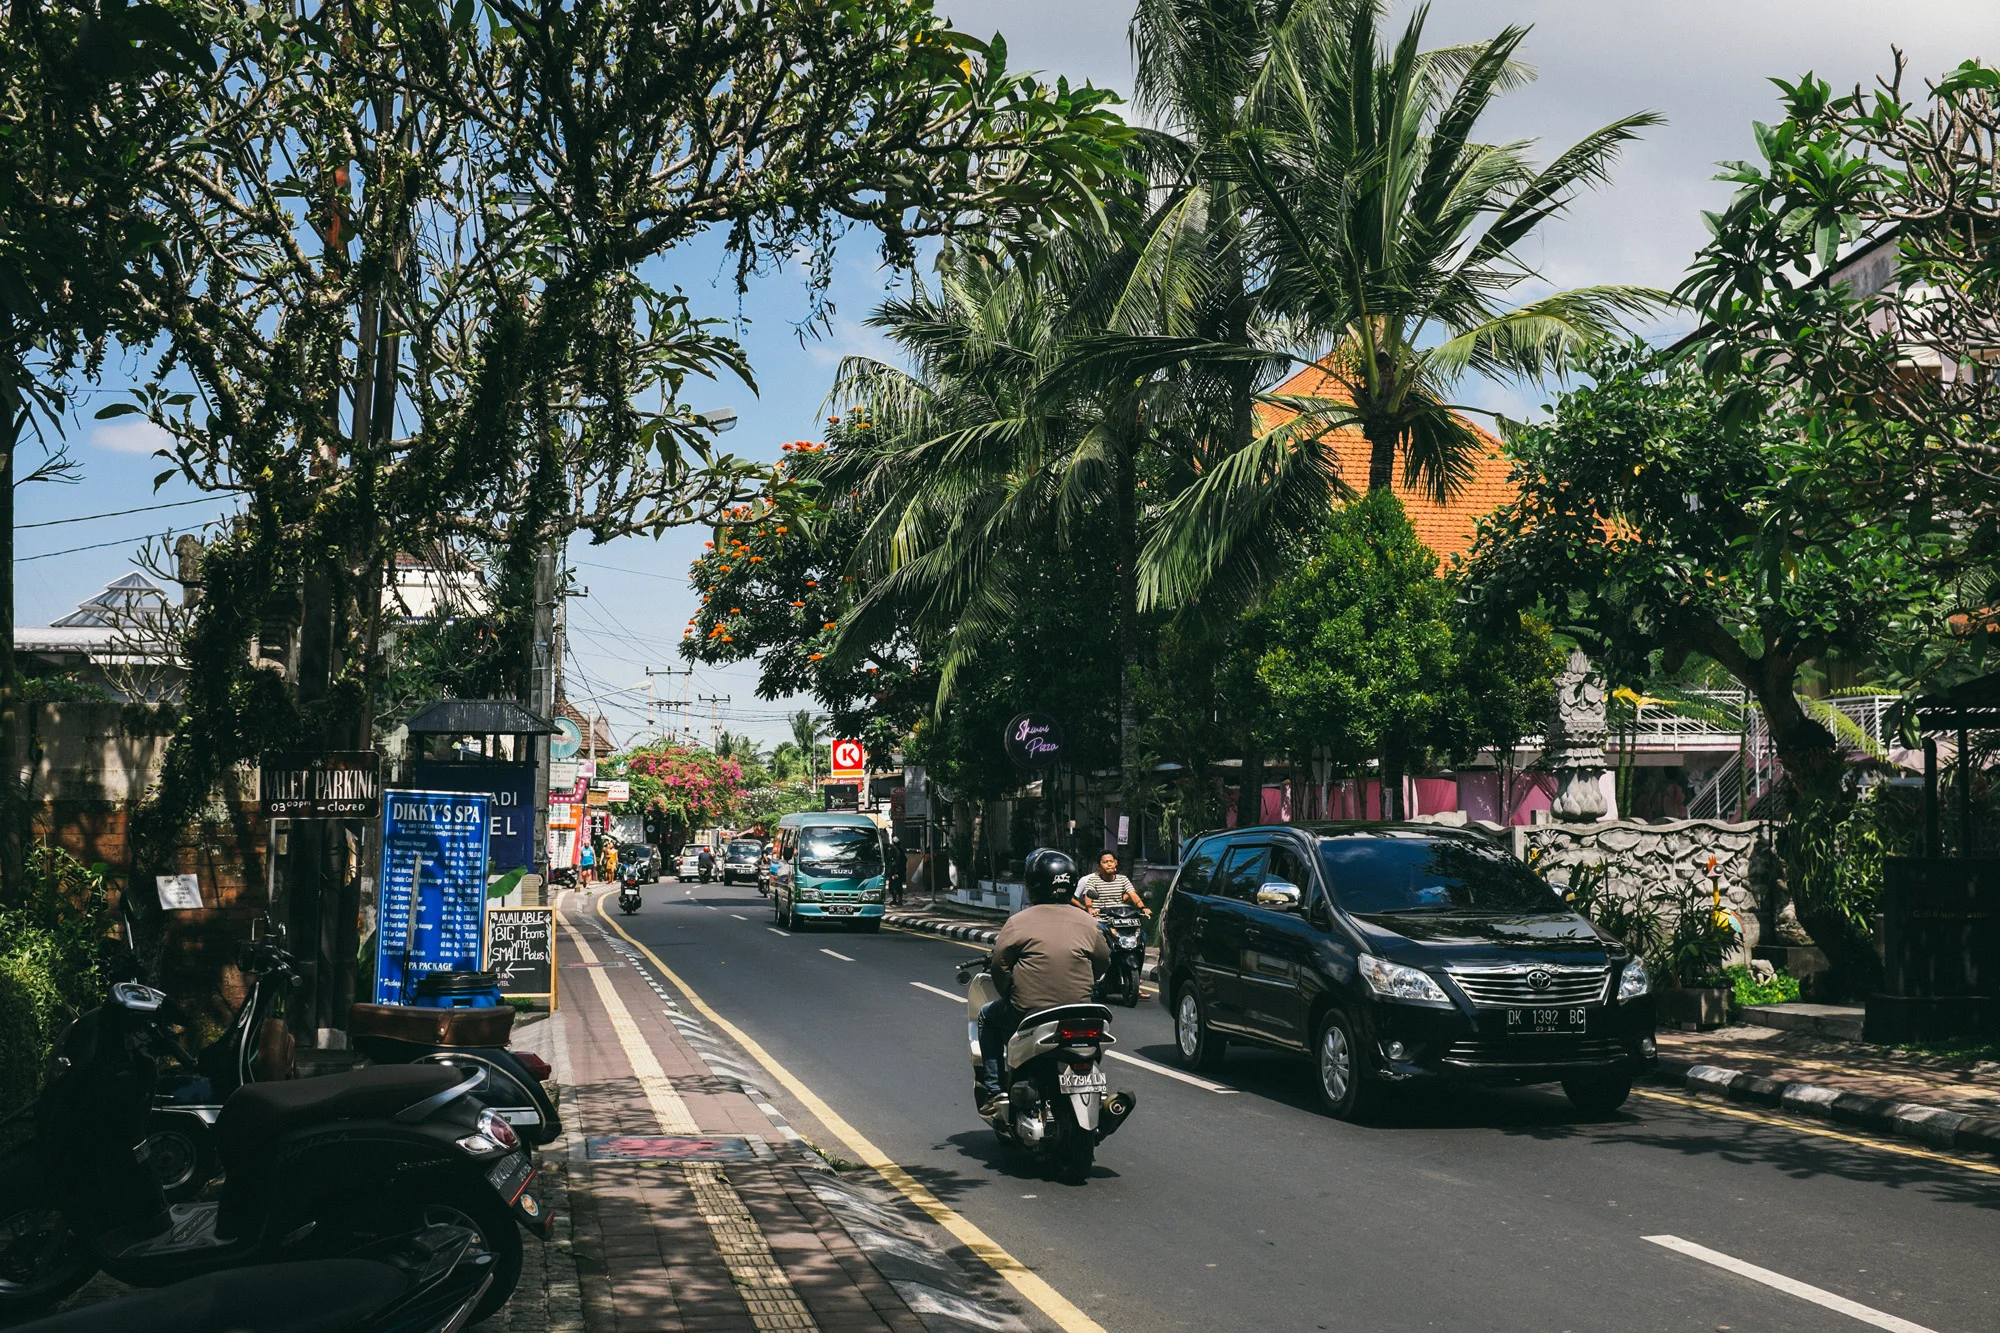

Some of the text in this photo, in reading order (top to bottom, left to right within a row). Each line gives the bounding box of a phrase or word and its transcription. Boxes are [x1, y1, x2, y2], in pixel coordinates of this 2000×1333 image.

[264, 770, 378, 799] VALET PARKING
[393, 803, 480, 823] DIKKY'S SPA
[498, 911, 544, 924] AVAILABLE
[495, 926, 515, 941] BIG
[492, 948, 521, 962] SMALL
[419, 962, 453, 971] PACKAGE
[1508, 1009, 1584, 1025] DK 1392 BC
[1060, 1076, 1072, 1086] DK
